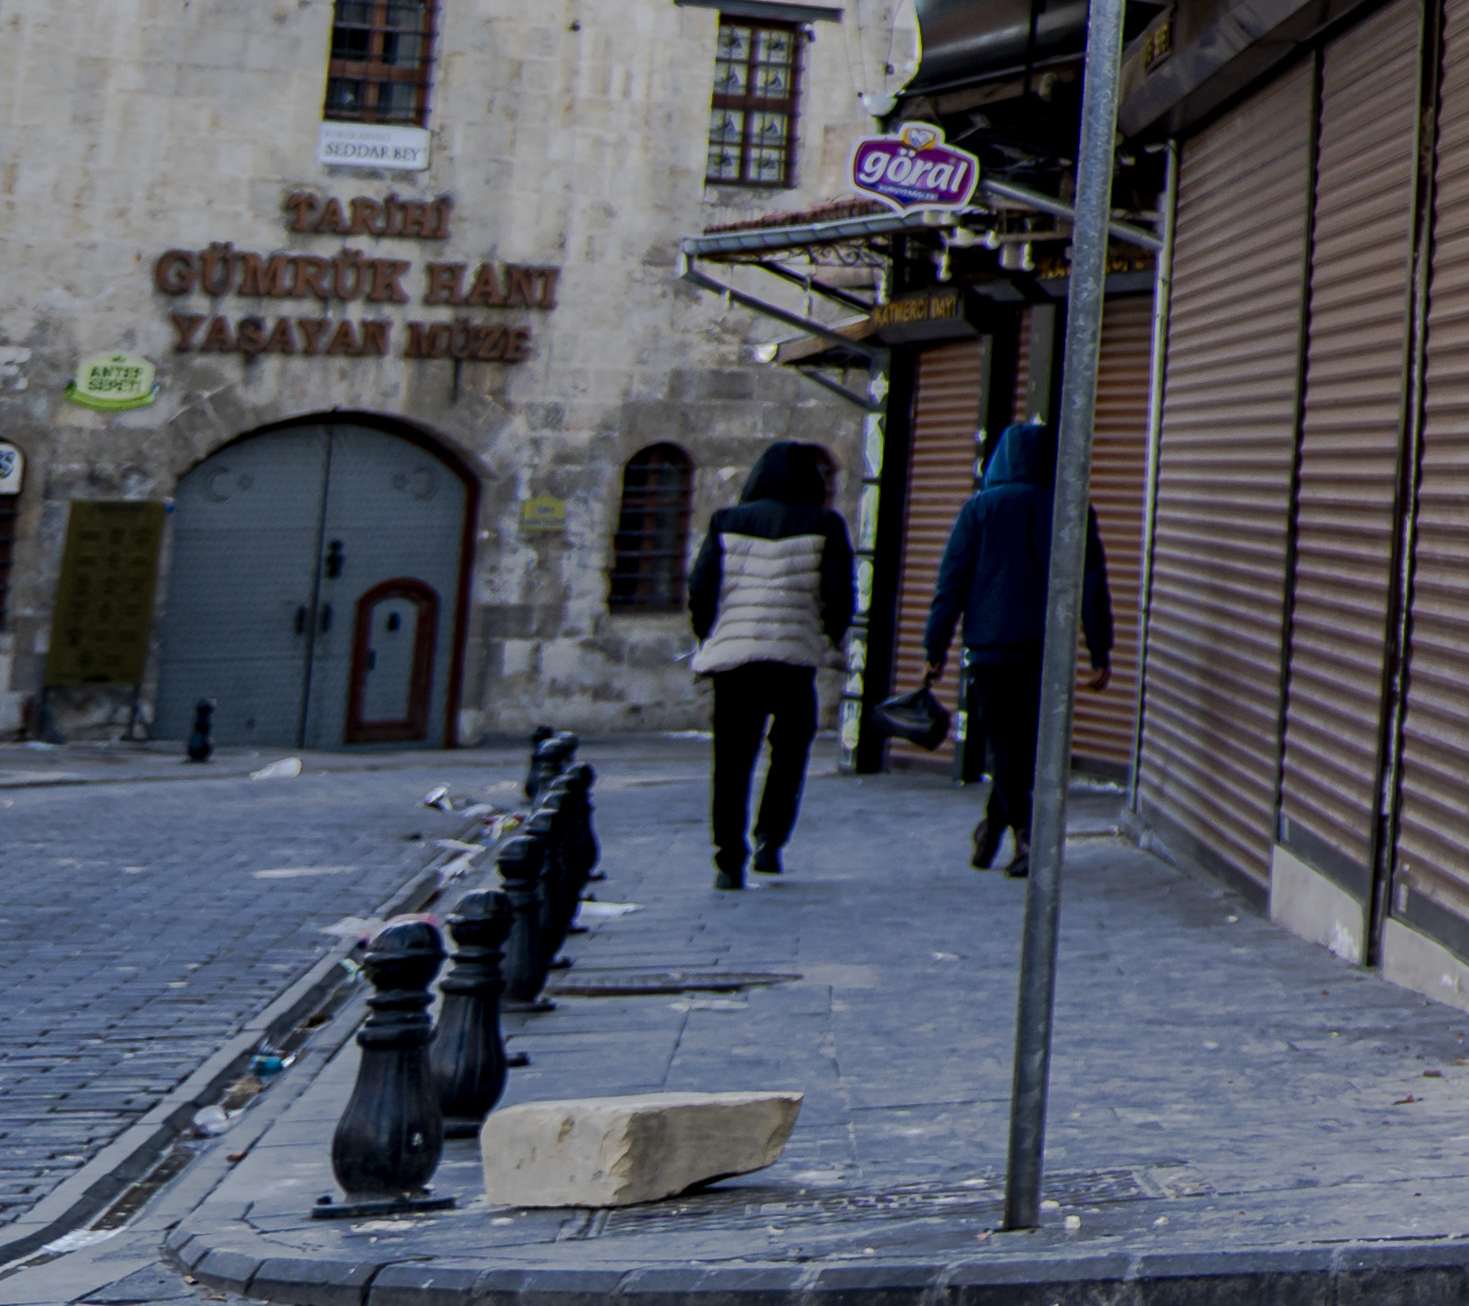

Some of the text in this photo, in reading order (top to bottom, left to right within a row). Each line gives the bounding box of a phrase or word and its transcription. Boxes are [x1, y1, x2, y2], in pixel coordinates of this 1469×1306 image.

[858, 147, 969, 194] göral
[285, 190, 455, 241] TARİHİ
[155, 240, 561, 311] GÜMRÜK HANI
[170, 313, 533, 366] YAŞAYAN MÜZE
